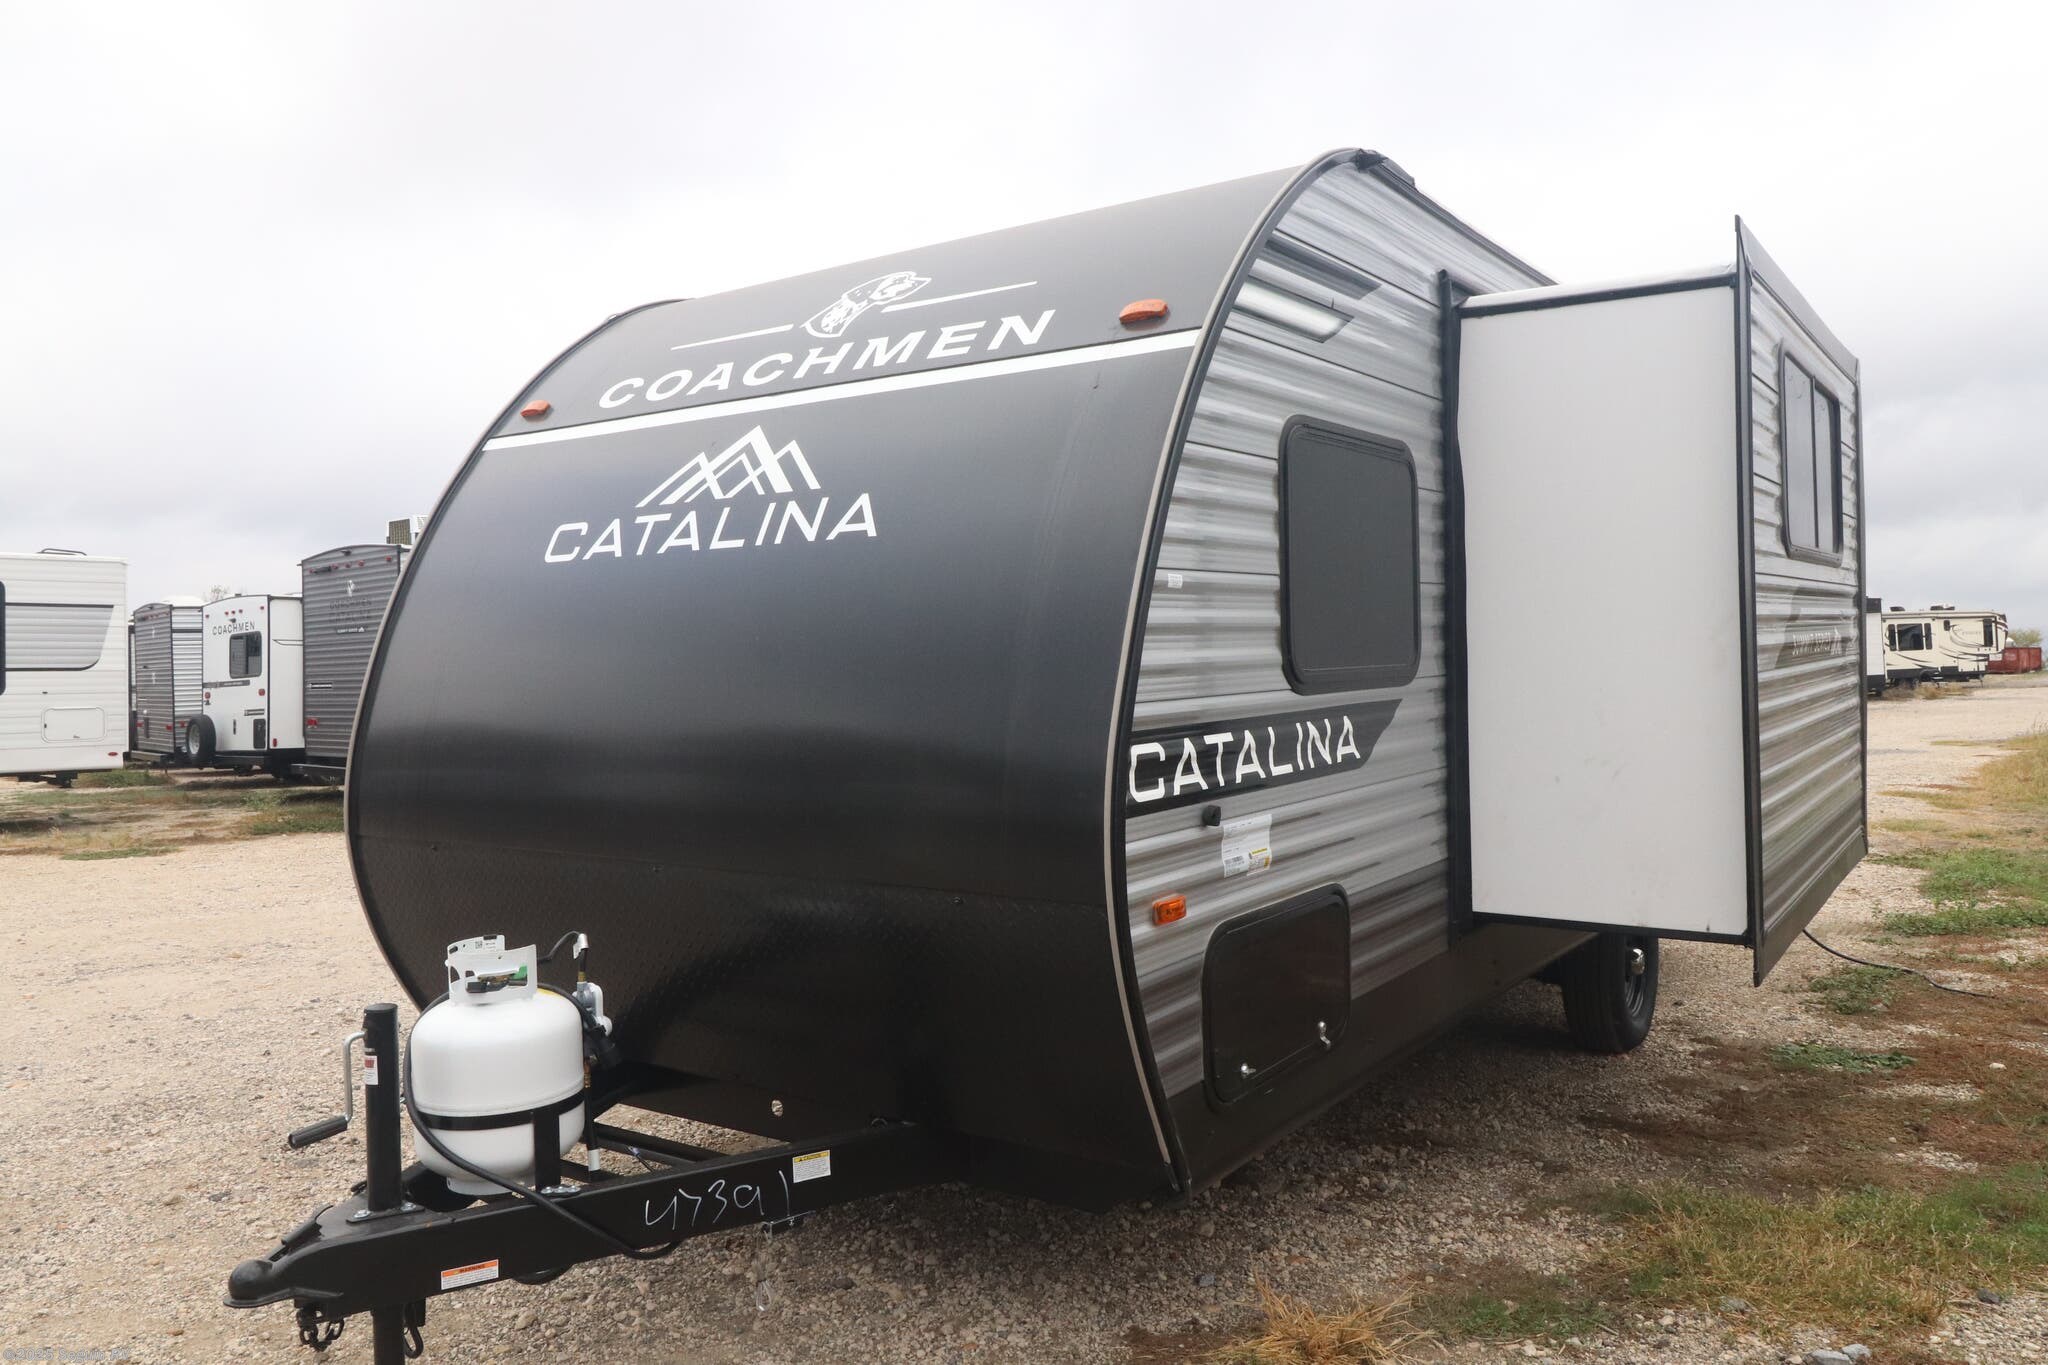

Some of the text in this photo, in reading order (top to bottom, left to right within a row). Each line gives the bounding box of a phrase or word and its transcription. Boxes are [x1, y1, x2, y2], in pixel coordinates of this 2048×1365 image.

[599, 309, 1056, 408] COACHMEN
[544, 493, 879, 564] CATALINA
[212, 621, 256, 636] COACHMEN
[1128, 714, 1361, 803] CATALINA
